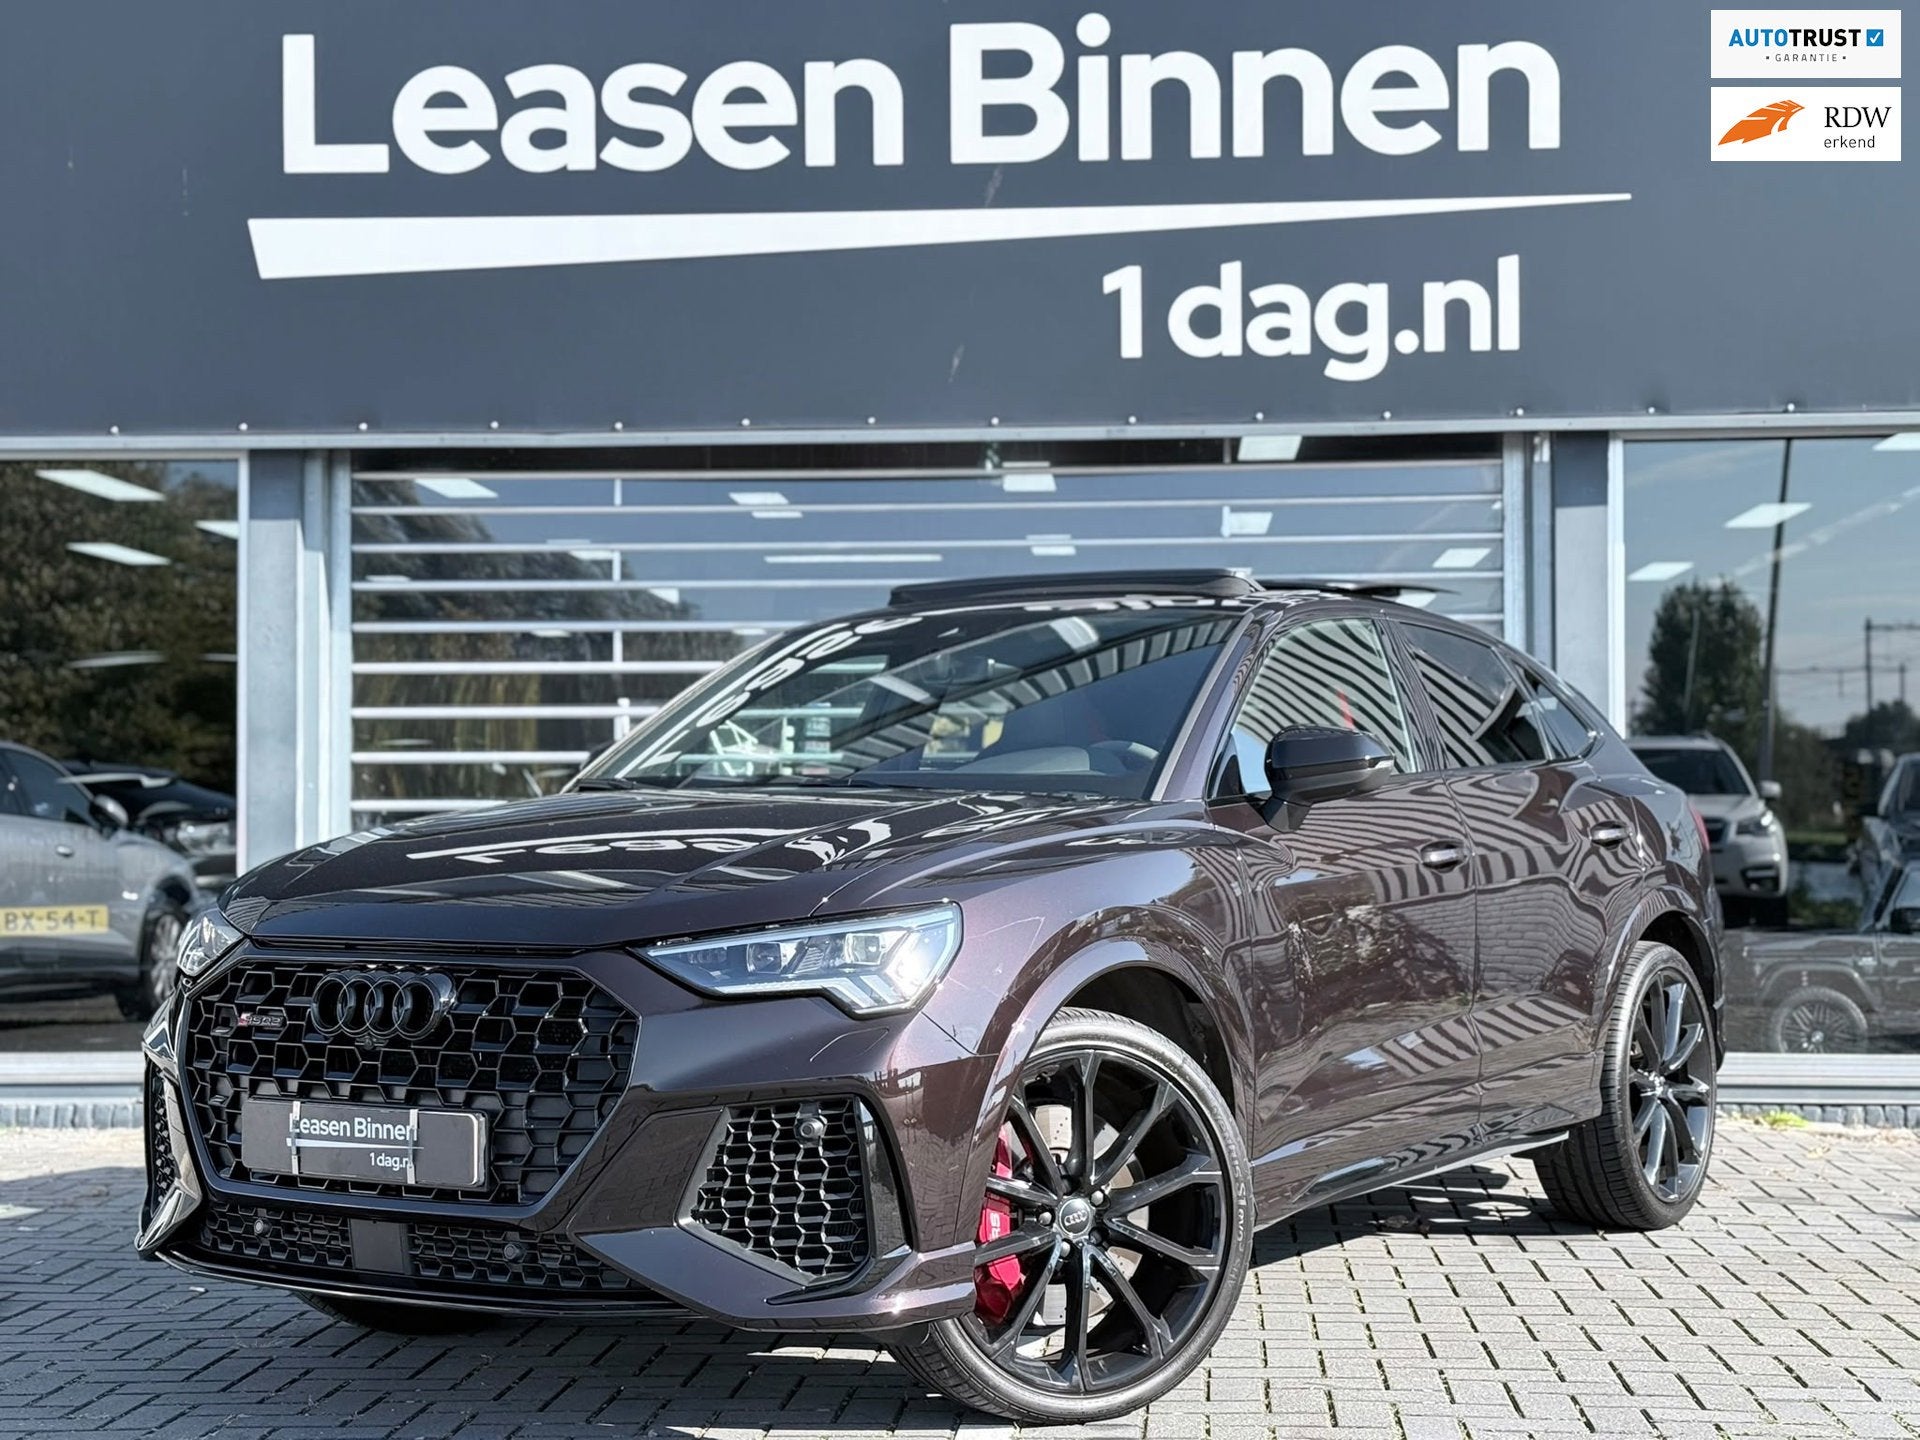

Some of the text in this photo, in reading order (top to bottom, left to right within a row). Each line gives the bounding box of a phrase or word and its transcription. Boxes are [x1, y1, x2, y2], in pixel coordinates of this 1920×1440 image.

[283, 13, 1560, 174] Leasen Binnen
[289, 1112, 350, 1137] Leasen
